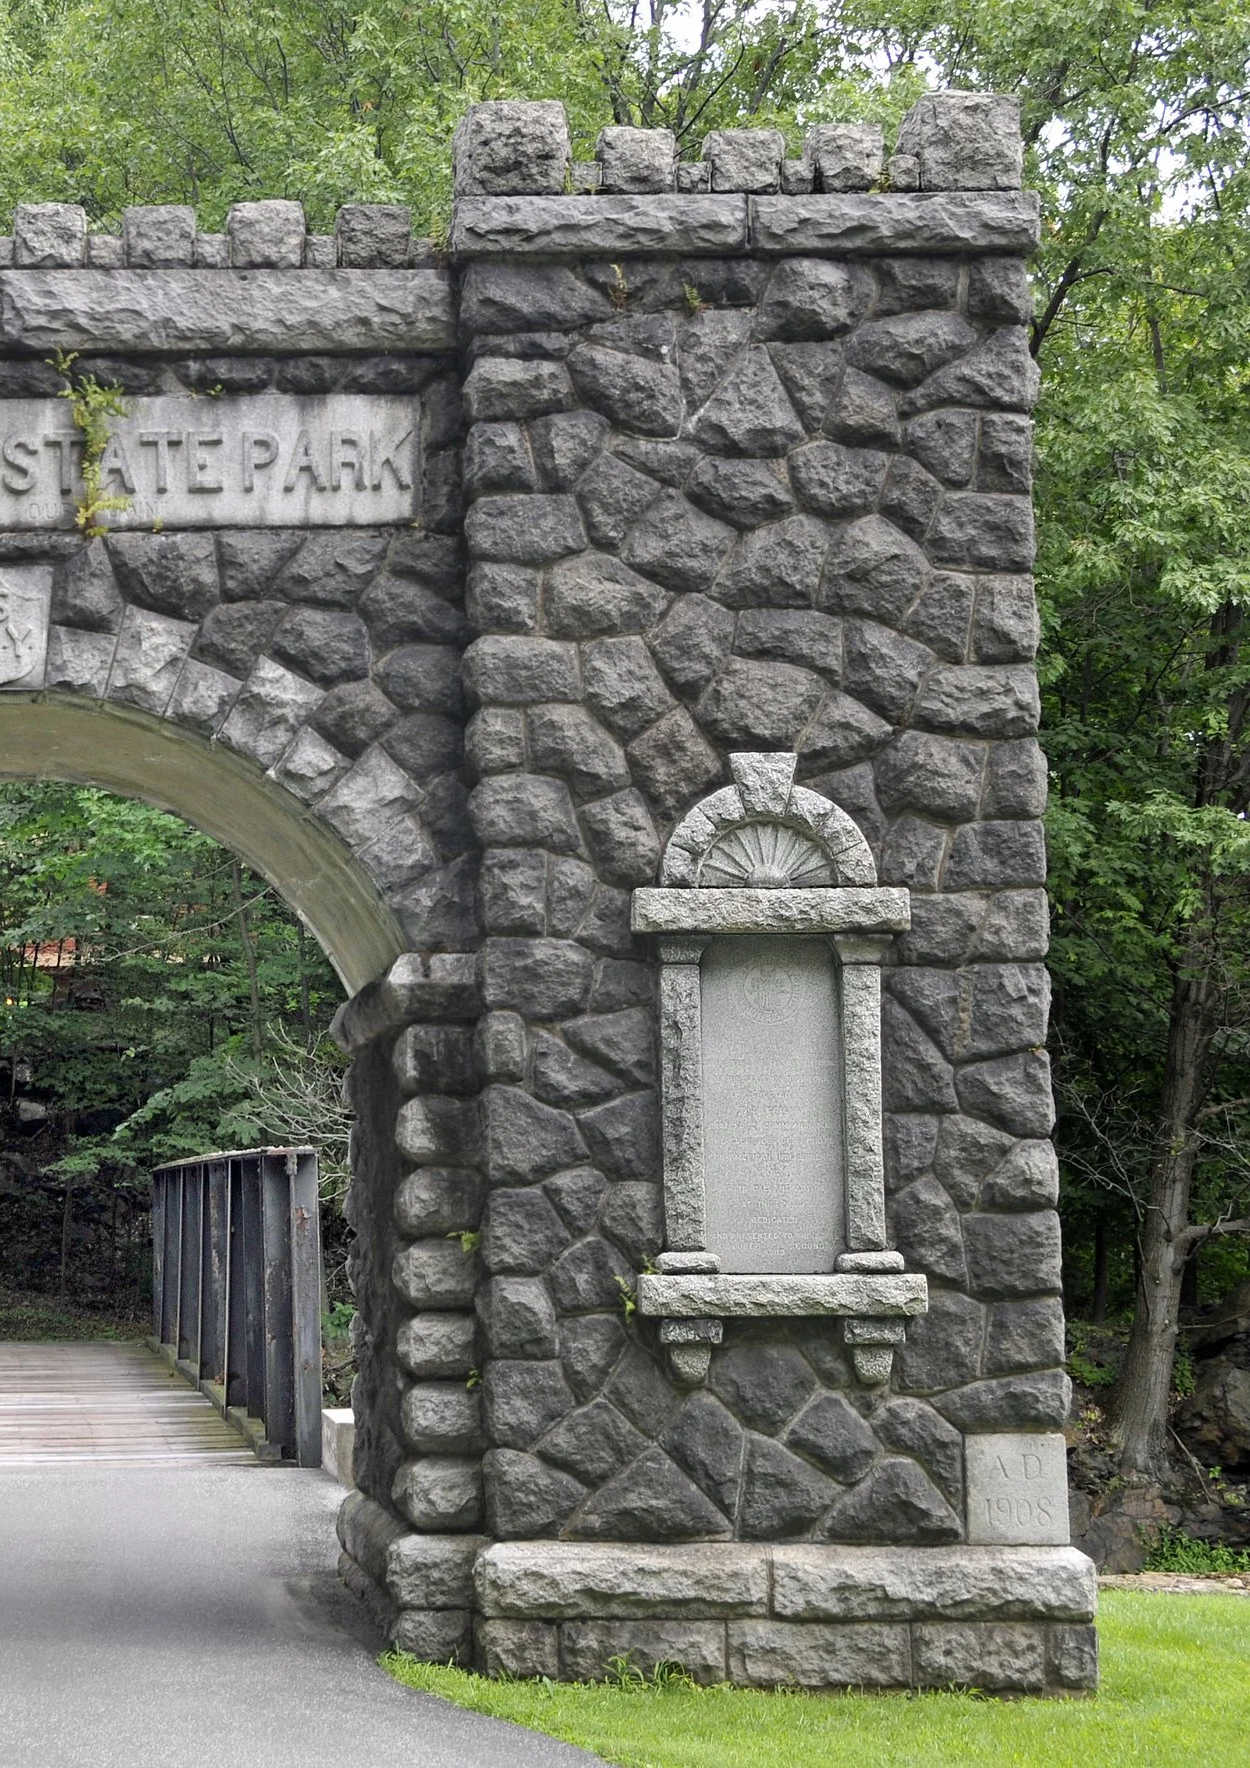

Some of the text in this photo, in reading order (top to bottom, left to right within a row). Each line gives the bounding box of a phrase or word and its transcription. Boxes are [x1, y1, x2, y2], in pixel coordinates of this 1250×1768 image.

[2, 431, 224, 495] STATE
[242, 429, 412, 492] PARK
[983, 1496, 1054, 1527] 1908
